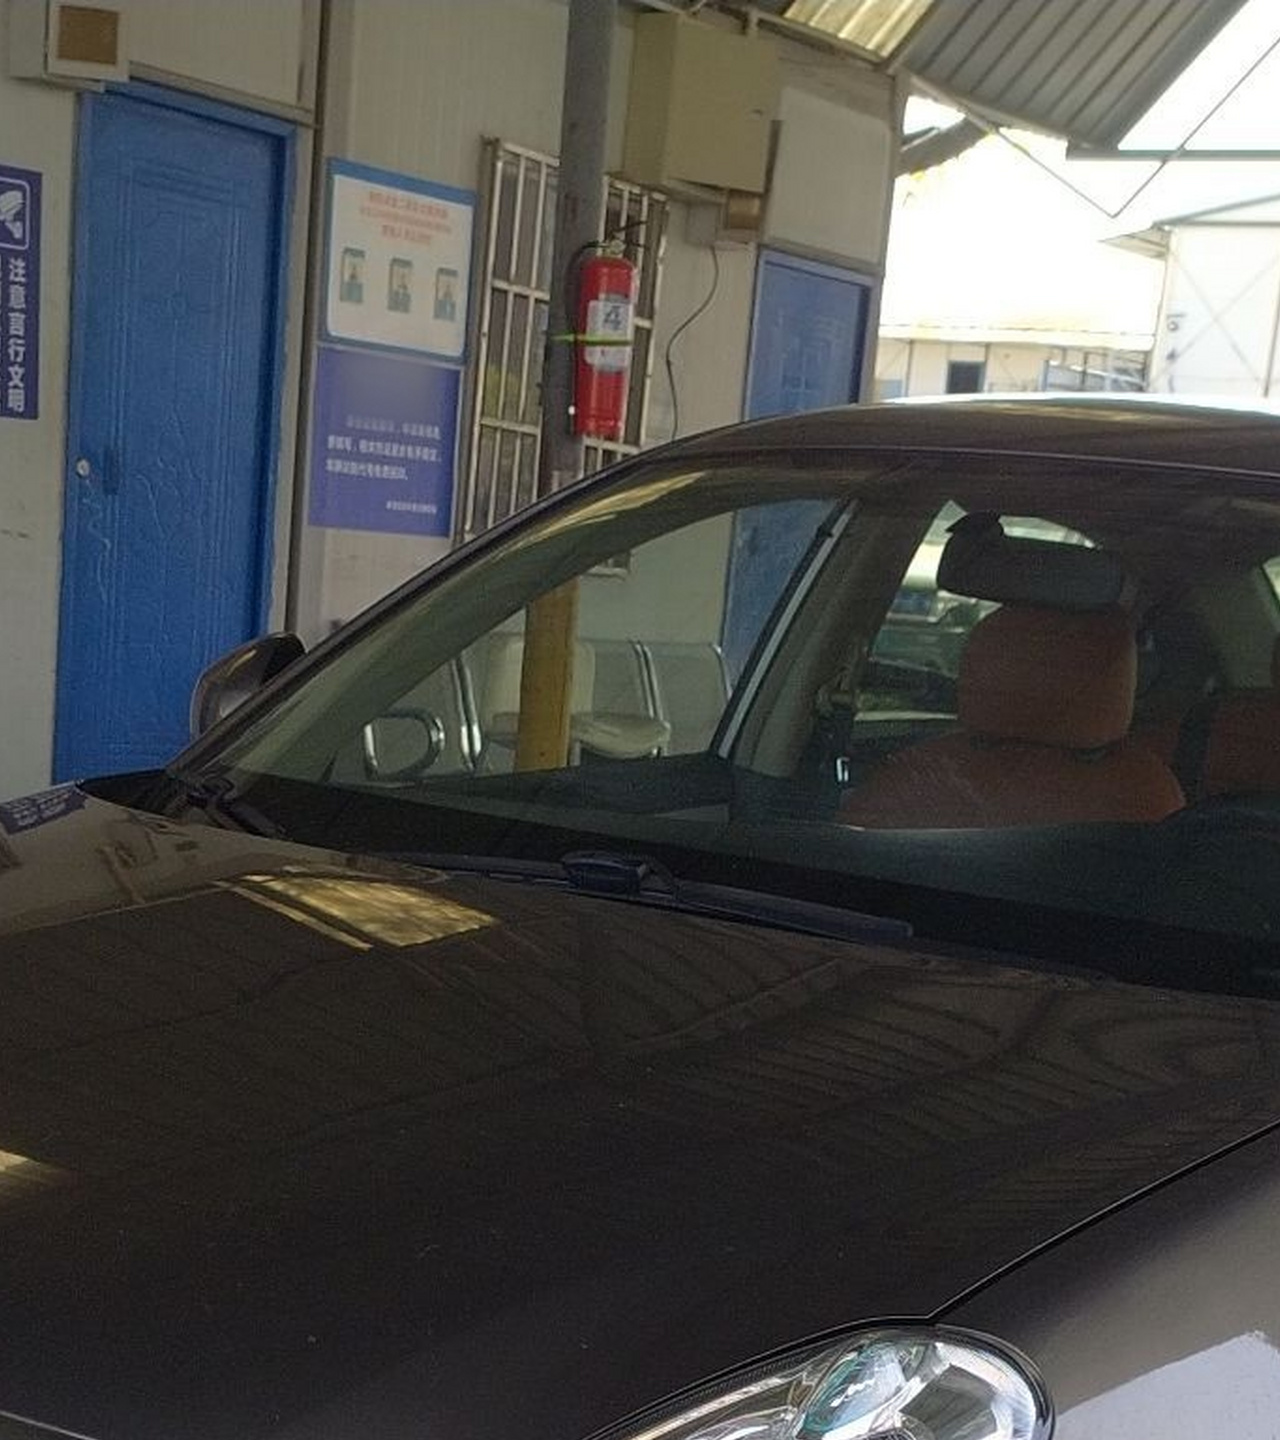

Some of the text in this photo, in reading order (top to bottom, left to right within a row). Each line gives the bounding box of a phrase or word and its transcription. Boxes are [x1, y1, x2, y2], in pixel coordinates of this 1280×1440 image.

[8, 257, 26, 412] 注意言行文明
